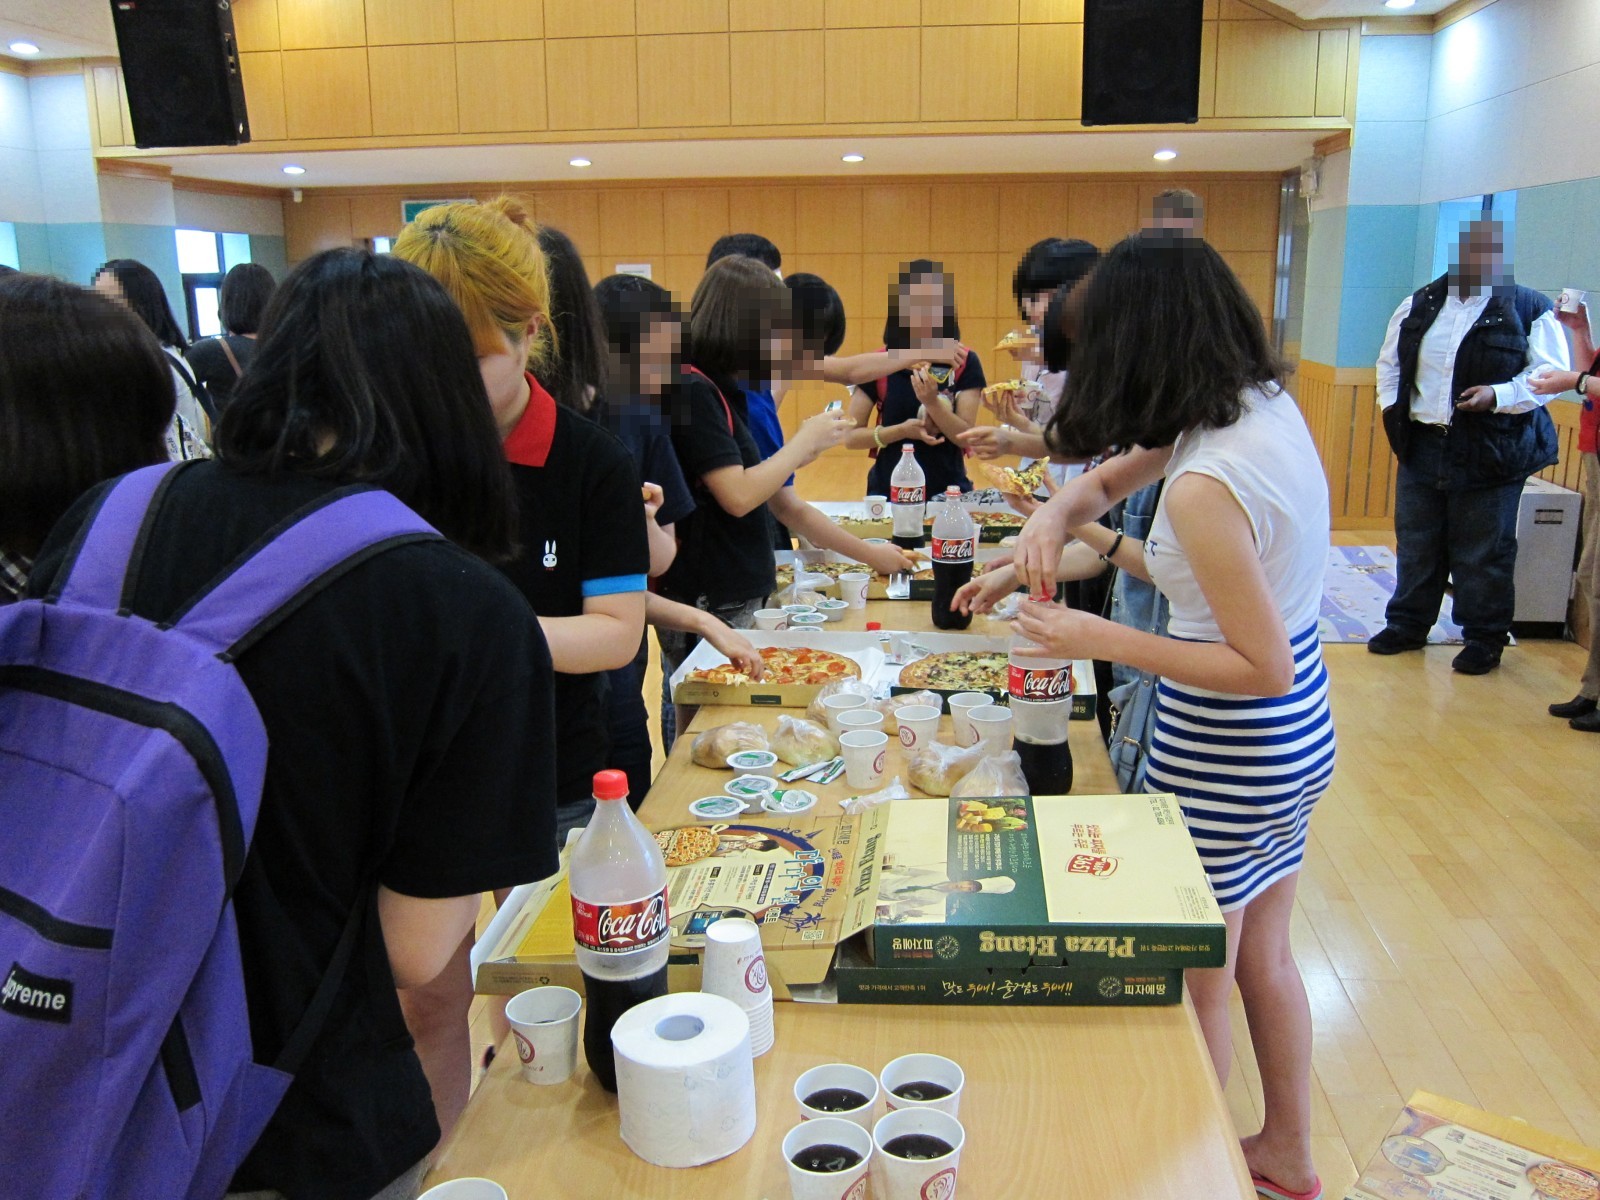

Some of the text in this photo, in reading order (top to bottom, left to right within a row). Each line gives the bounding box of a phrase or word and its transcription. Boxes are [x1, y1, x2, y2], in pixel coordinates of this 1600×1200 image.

[941, 540, 973, 558] Coca-Cola
[1024, 669, 1070, 696] Coca-Cola
[858, 833, 882, 868] Etang
[1071, 856, 1094, 873] 3651
[771, 849, 825, 906] 다다익선
[853, 864, 873, 898] Pizza
[598, 893, 667, 944] Coca-Cola
[892, 937, 934, 950] 피자에땅
[979, 930, 1058, 957] Etang
[1064, 935, 1136, 958] Pizza
[942, 979, 1073, 999] 맛도 두배! 즐거움도 두배!!
[1124, 983, 1166, 995] 피자에땅
